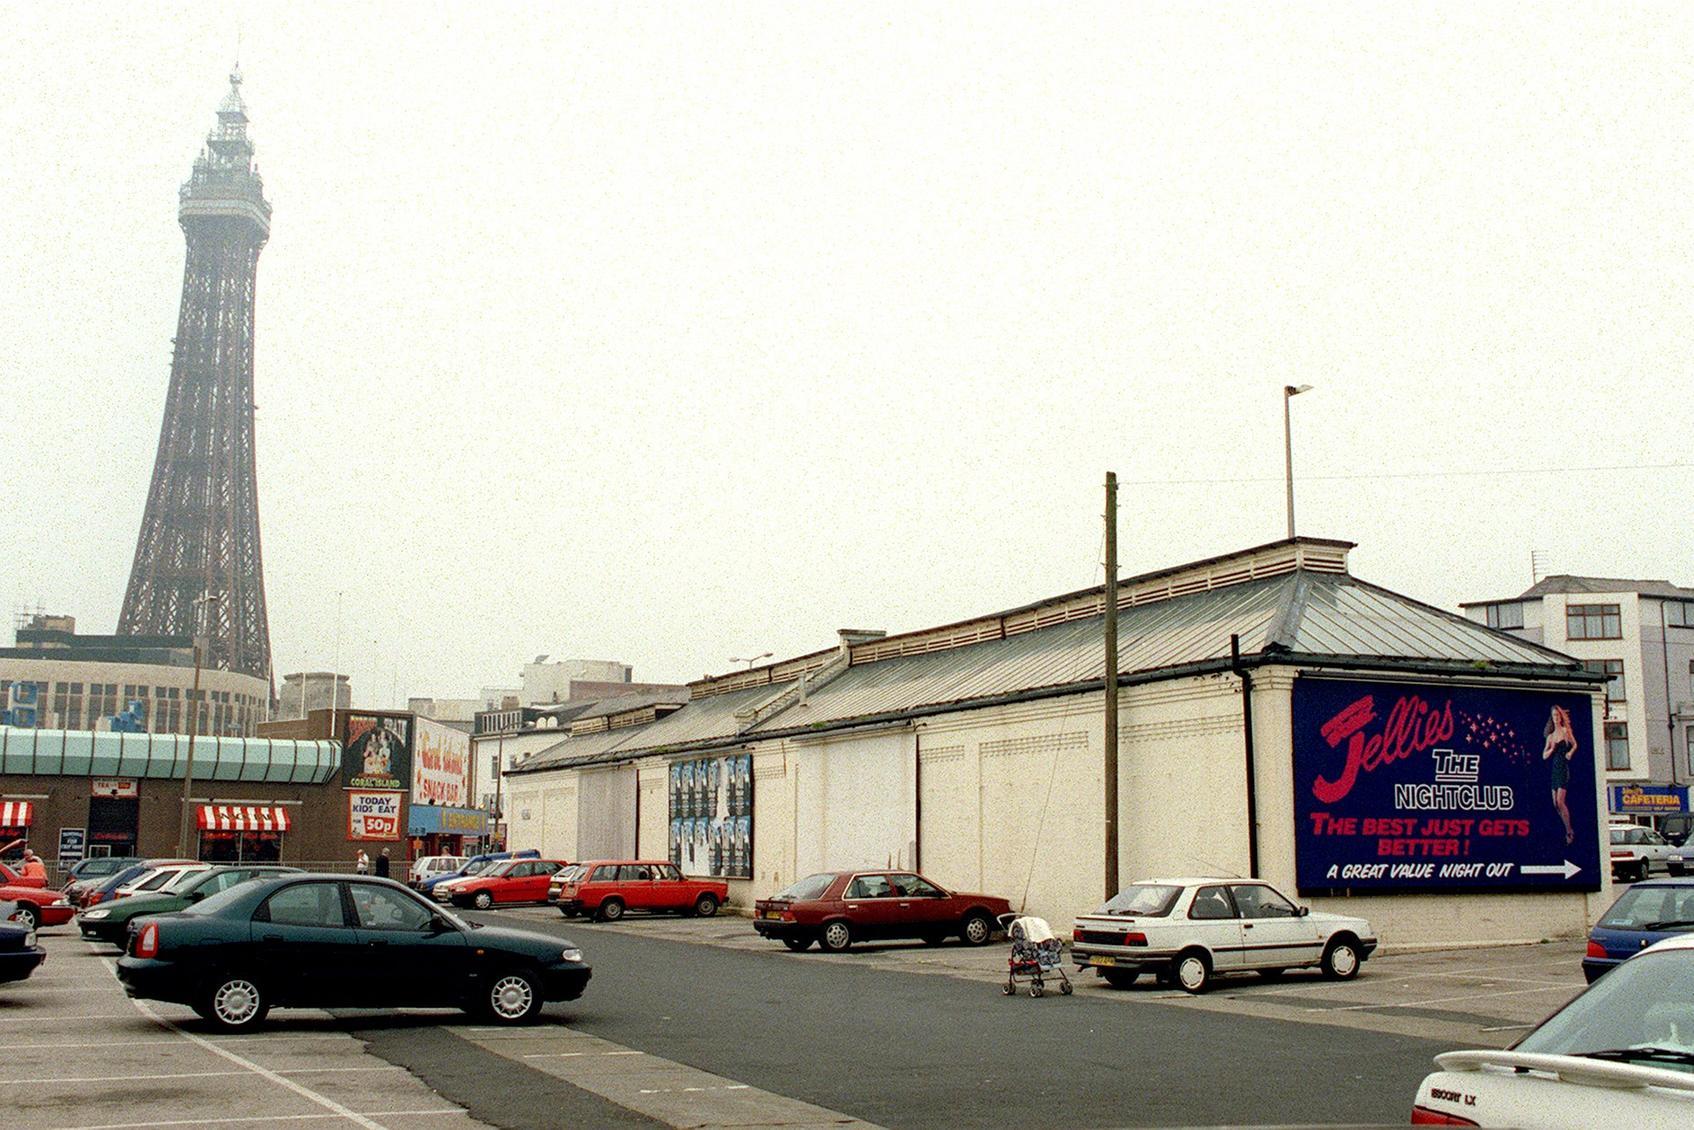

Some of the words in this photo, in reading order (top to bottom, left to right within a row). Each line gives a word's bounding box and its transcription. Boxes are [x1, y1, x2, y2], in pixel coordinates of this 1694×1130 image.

[1312, 695, 1455, 804] Jellies
[1432, 749, 1480, 774] THE
[359, 796, 392, 805] TODAY
[1395, 784, 1514, 810] NIGHTCLUB
[1622, 795, 1681, 806] CAFETERIA
[352, 804, 374, 813] KIDS
[378, 805, 397, 814] EAT
[366, 818, 392, 833] 50p
[1310, 812, 1357, 836] THE
[1362, 818, 1418, 836] BEST
[1420, 819, 1476, 836] JUST
[1478, 820, 1530, 836] GETS
[1326, 864, 1338, 879] A
[1342, 863, 1389, 879] GREAT
[1390, 863, 1435, 879] VALUE
[1439, 862, 1483, 878] NIGHT
[1486, 862, 1515, 878] OUT
[1464, 1094, 1477, 1106] LX
